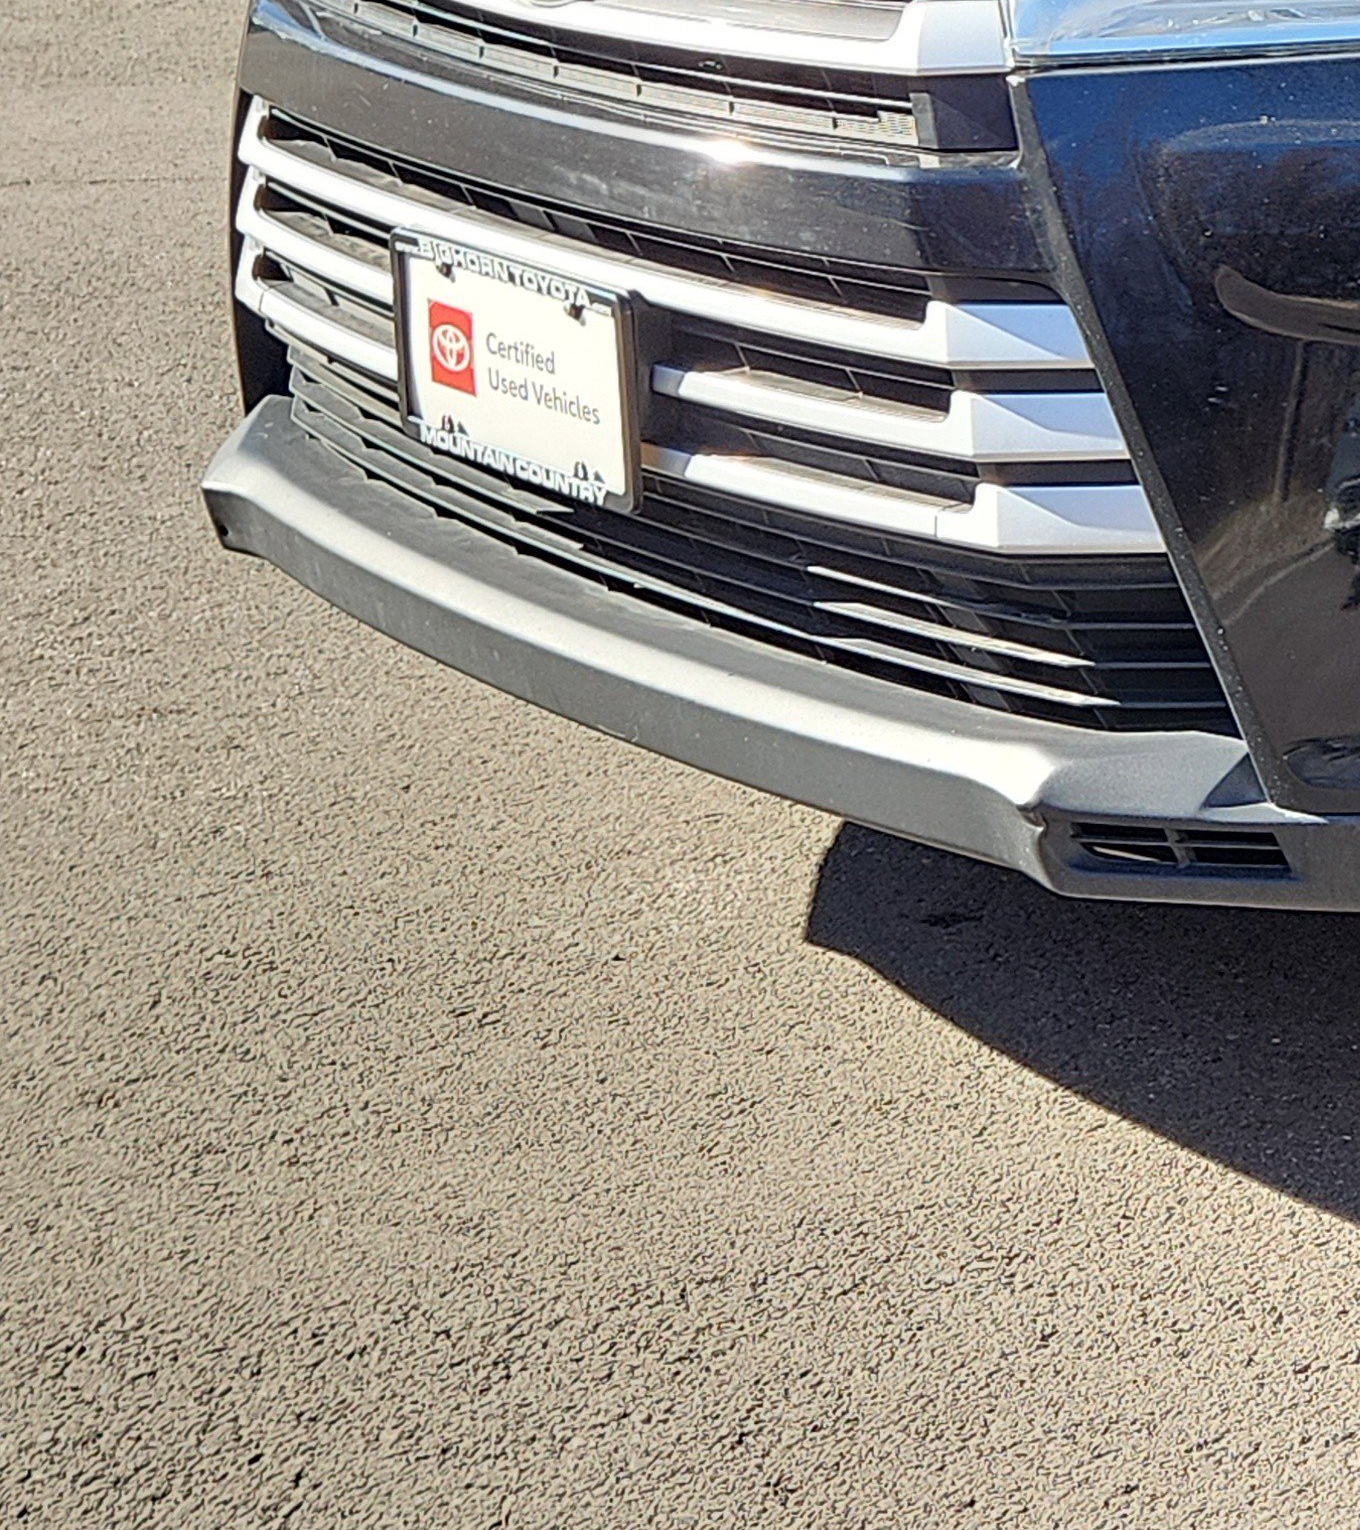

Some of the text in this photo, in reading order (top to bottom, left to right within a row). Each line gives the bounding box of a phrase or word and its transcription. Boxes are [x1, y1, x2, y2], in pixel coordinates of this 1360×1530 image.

[486, 332, 555, 374] Certified
[488, 367, 600, 424] Used Vehicles
